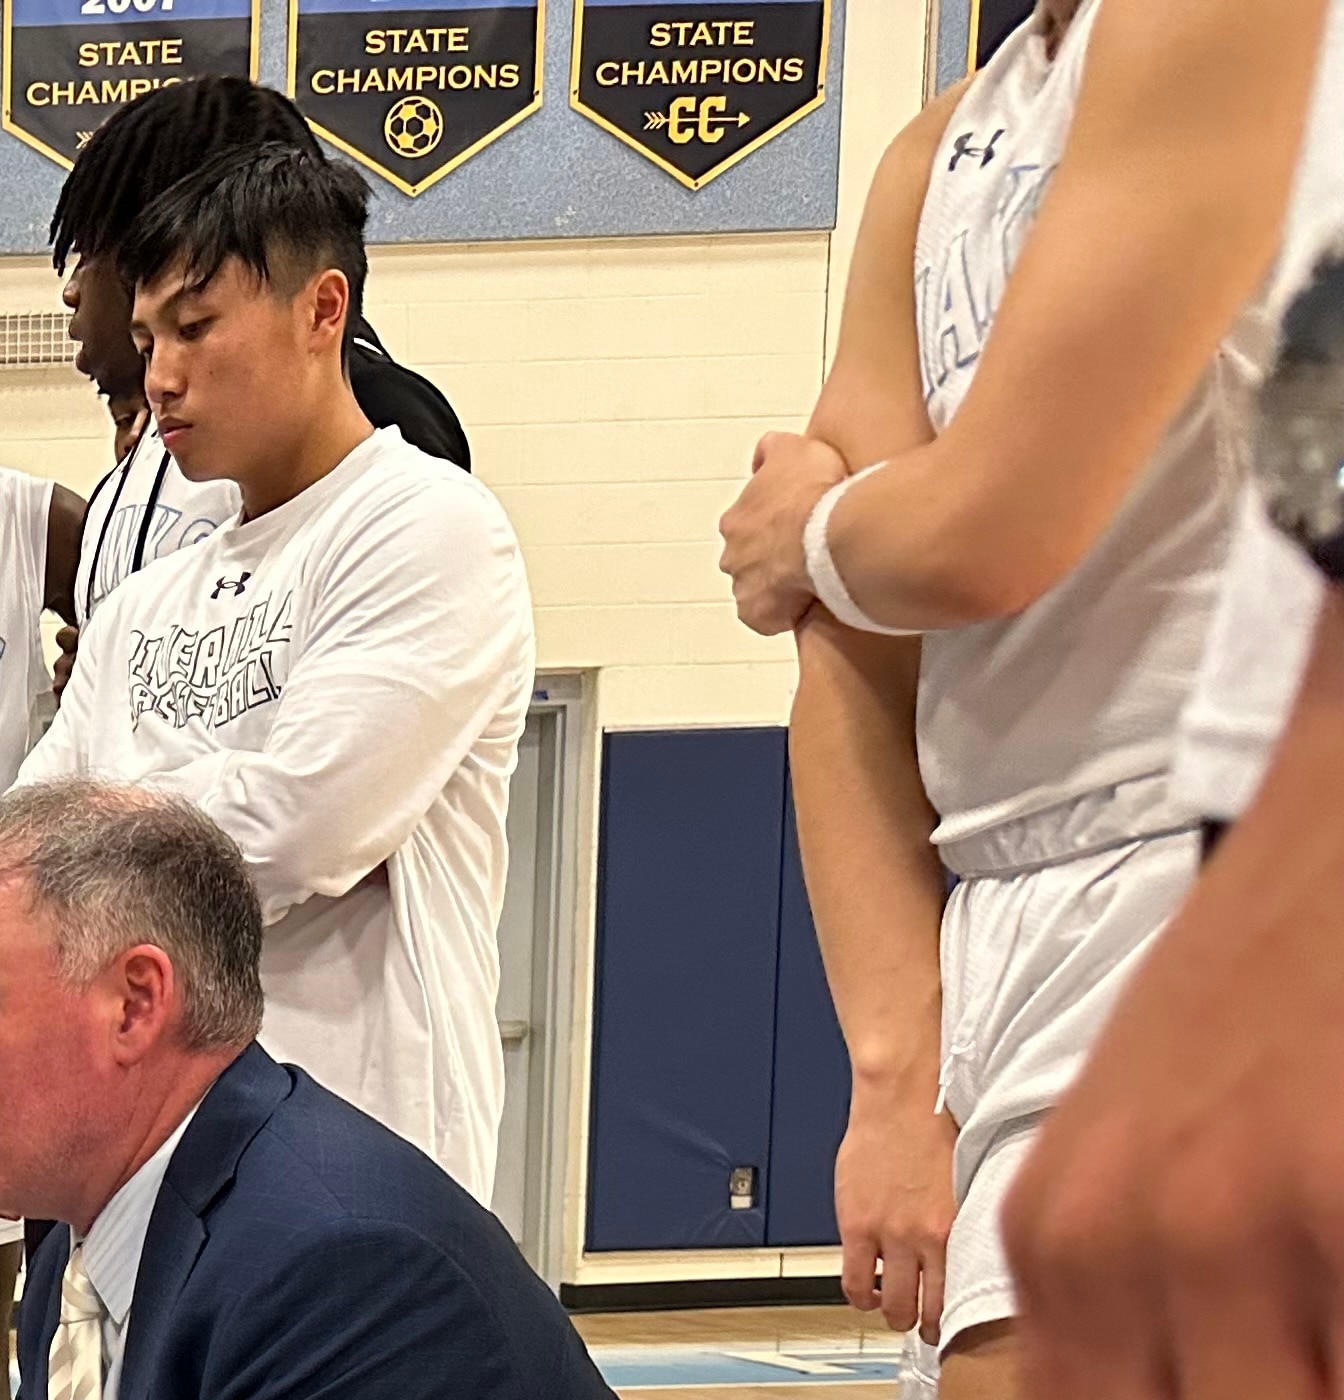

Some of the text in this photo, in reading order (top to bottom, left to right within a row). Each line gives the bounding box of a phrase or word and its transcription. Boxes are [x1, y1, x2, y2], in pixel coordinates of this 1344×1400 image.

[366, 28, 468, 53] STATE
[650, 22, 754, 46] STATE
[79, 39, 182, 66] STATE
[312, 65, 519, 93] CHAMPIONS
[596, 58, 803, 85] CHAMPIONS
[26, 77, 194, 107] CHAMP
